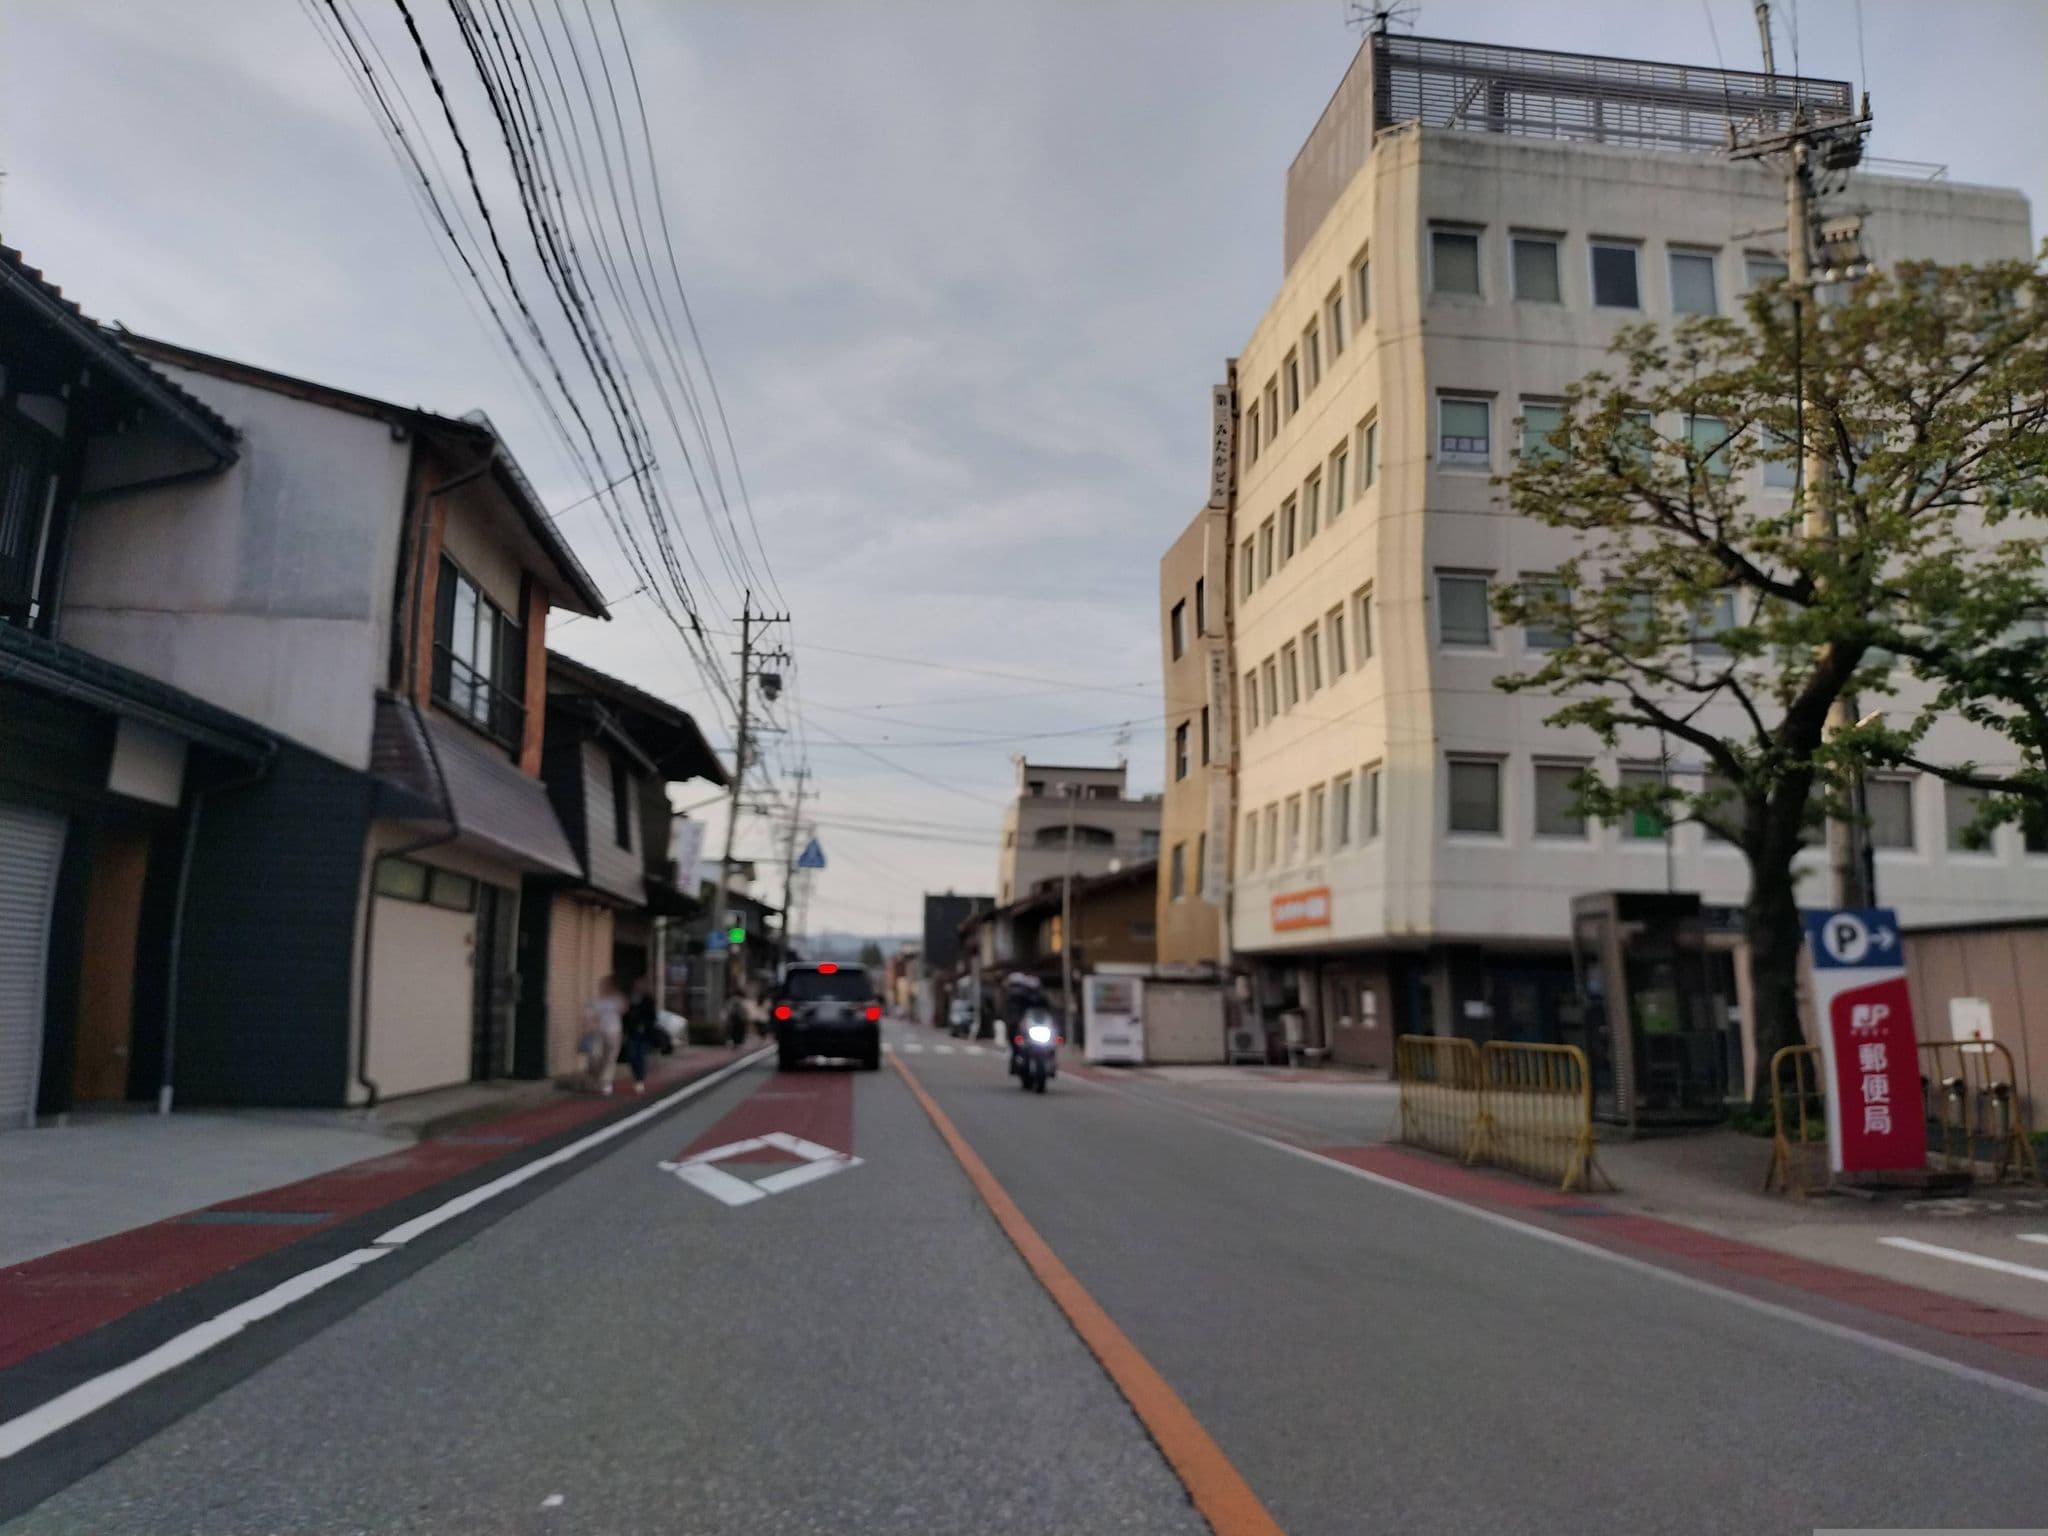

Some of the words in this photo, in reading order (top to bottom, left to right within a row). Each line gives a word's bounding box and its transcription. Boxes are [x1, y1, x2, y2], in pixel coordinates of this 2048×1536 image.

[1836, 924, 1857, 953] P
[1858, 1043, 1892, 1135] 郵便局
